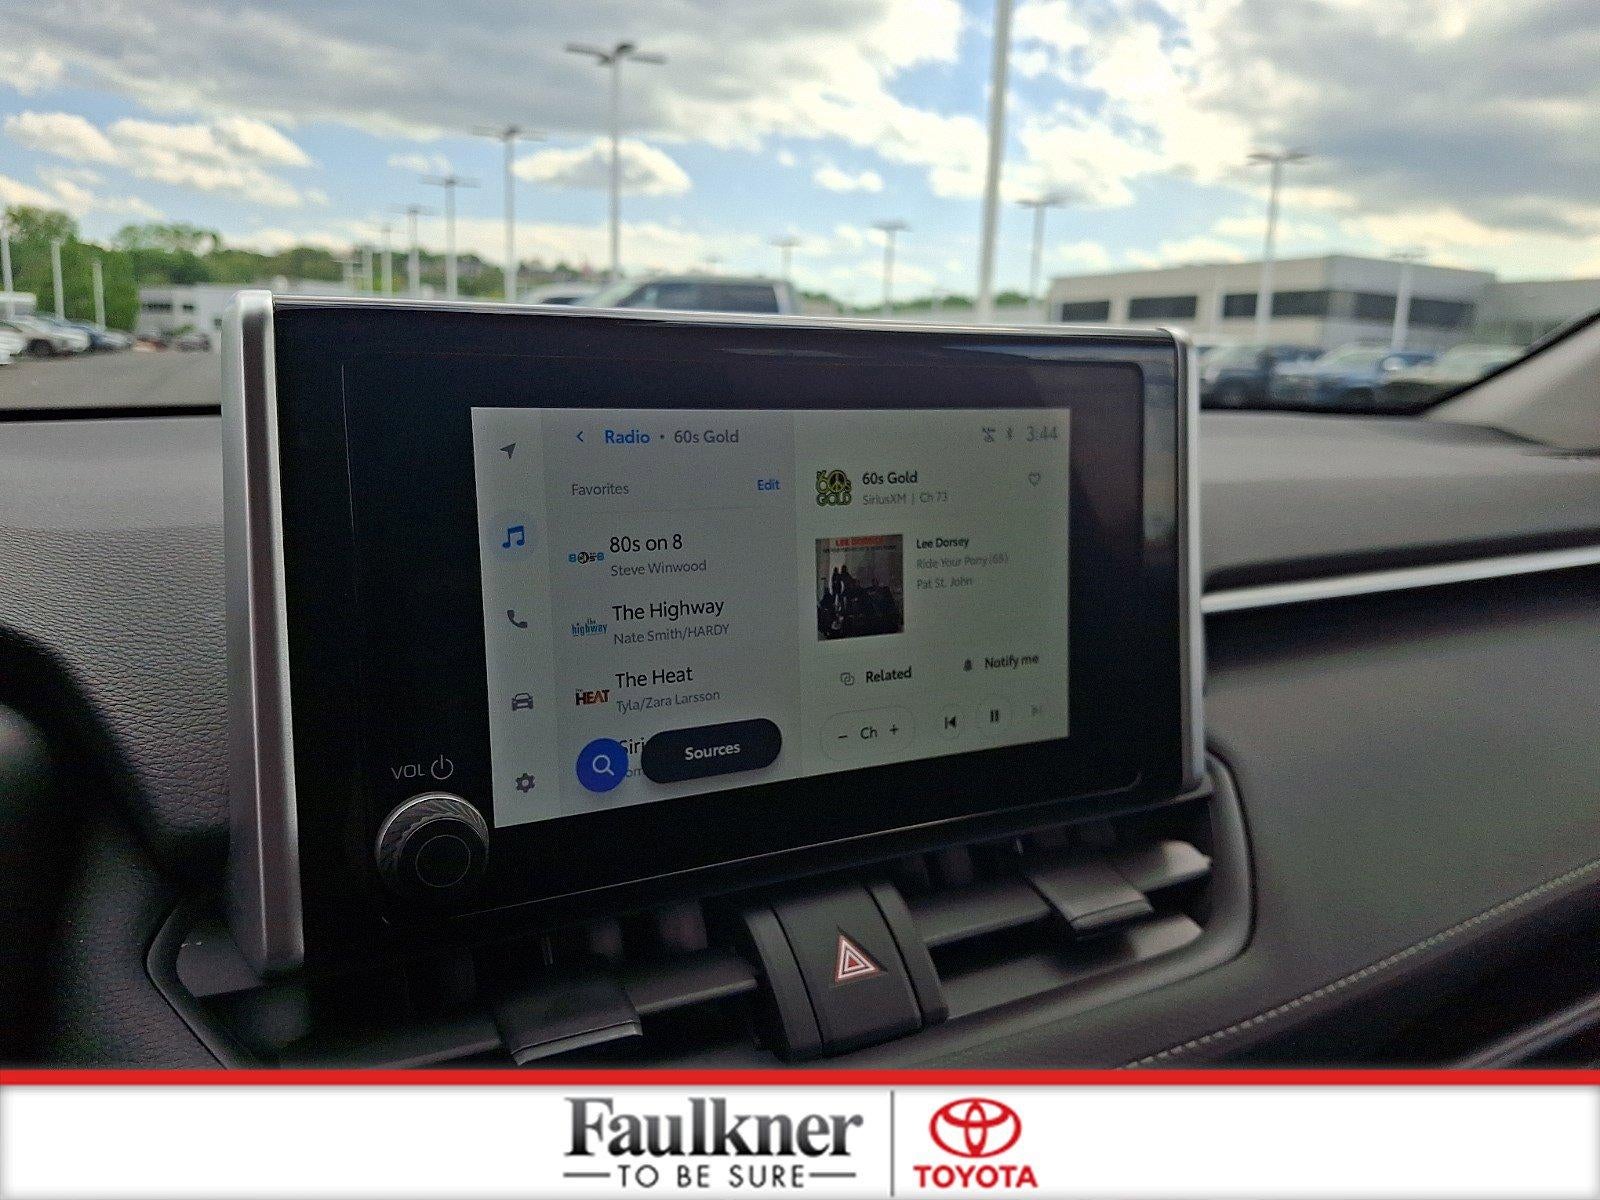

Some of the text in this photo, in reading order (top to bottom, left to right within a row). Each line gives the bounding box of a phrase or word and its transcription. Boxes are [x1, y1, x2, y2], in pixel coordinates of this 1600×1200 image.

[604, 429, 739, 445] Radio 60s Gold
[862, 470, 918, 485] 60s Gold
[571, 482, 629, 496] Favorites
[757, 479, 780, 492] Edit
[816, 492, 852, 506] GOLD
[862, 494, 907, 506] SiriusXM
[609, 534, 683, 553] 80s on 8
[916, 537, 969, 549] Lee Dorsey
[610, 559, 708, 577] Steve Winwood
[916, 558, 939, 570] Ride
[916, 578, 932, 590] Pat
[612, 600, 725, 621] The Highway
[571, 623, 608, 637] highway
[614, 623, 730, 645] Nate Smith/HARDY
[985, 655, 1039, 669] Notify me
[615, 666, 693, 689] The Heat
[866, 666, 912, 683] Related
[575, 689, 610, 705] HEAT
[616, 690, 720, 715] Tyla/Zara Larsson
[860, 727, 878, 740] Ch
[685, 743, 741, 761] Sources
[391, 764, 425, 780] VOL
